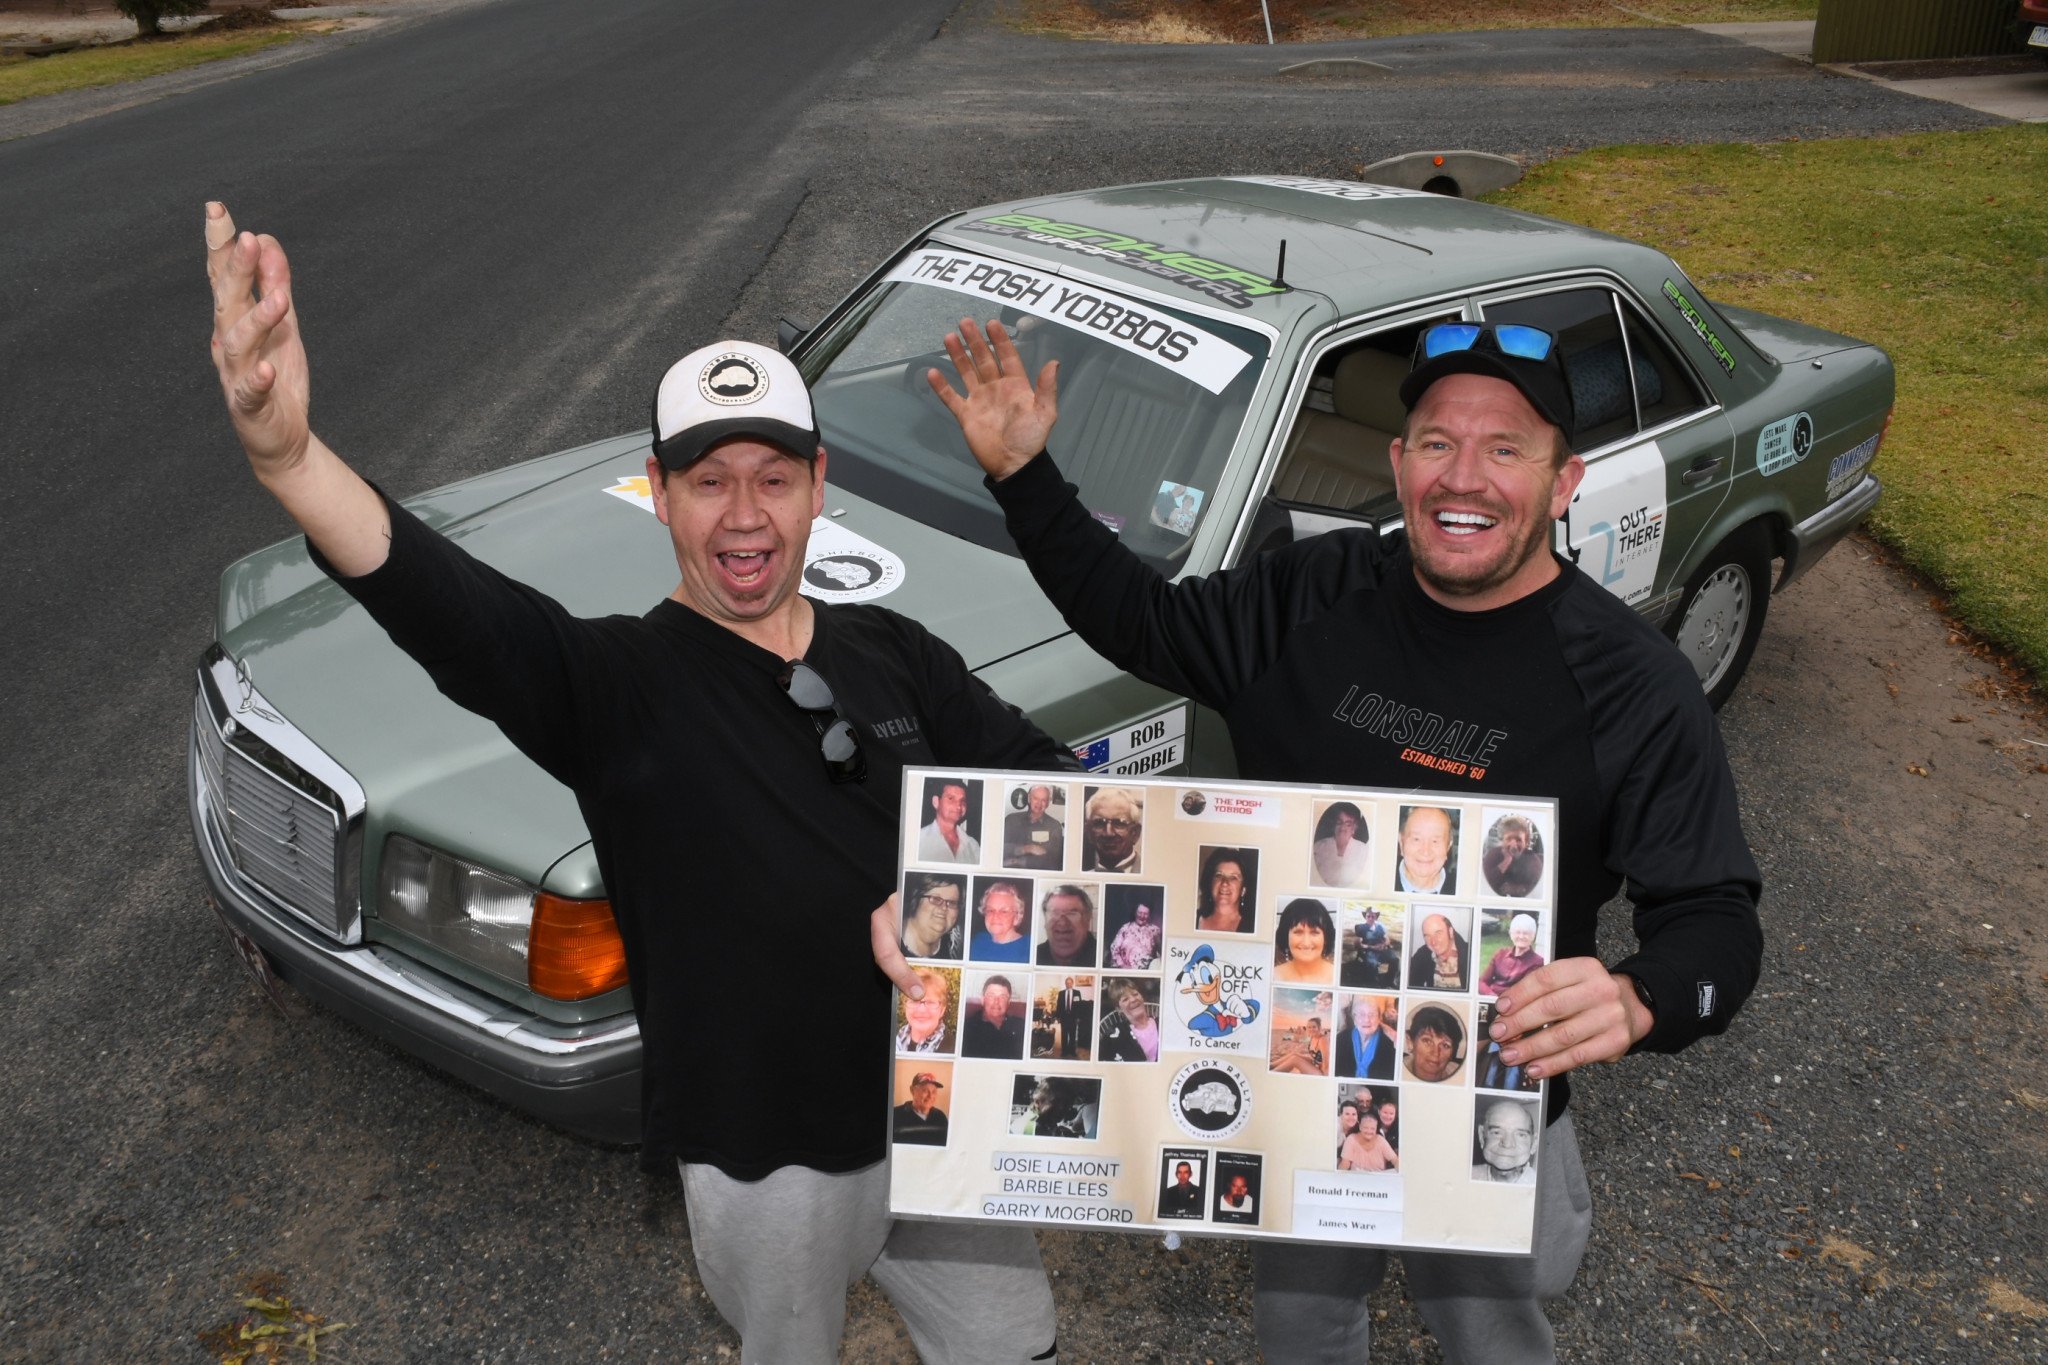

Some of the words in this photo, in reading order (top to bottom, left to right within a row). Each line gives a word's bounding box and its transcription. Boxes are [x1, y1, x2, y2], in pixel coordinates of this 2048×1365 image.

[976, 213, 1286, 296] BENHER
[911, 255, 971, 283] THE
[960, 262, 1054, 306] POSH
[1050, 287, 1199, 363] YOBBOS
[1663, 279, 1734, 370] BENHER
[701, 354, 736, 382] SHITBOX
[743, 357, 766, 381] RALLY
[1620, 506, 1648, 533] OUT
[1619, 521, 1662, 554] THERE
[1615, 542, 1659, 568] INTERNET
[1131, 720, 1165, 749] ROB
[1332, 684, 1508, 767] LONSDALE
[1400, 748, 1467, 776] ESTABLISHED
[1214, 797, 1233, 806] THE
[1236, 799, 1262, 808] POSH
[1214, 805, 1253, 815] YOBBOS
[1170, 947, 1190, 960] Say
[1223, 965, 1263, 981] DUCK
[1221, 980, 1249, 994] OFF
[1189, 1036, 1201, 1047] To
[1205, 1037, 1241, 1050] Cancer
[1171, 1060, 1218, 1095] SHITBOX
[1226, 1065, 1251, 1103] RALLY
[994, 1158, 1042, 1173] JOSIE
[1047, 1160, 1120, 1177] LAMONT
[1003, 1178, 1063, 1195] BARBIE
[1067, 1182, 1108, 1197] LEES
[1308, 1186, 1342, 1196] Ronald
[1345, 1189, 1389, 1199] Freeman
[983, 1202, 1041, 1217] GARRY
[1045, 1205, 1133, 1223] MOGFORD
[1318, 1219, 1348, 1229] James
[1351, 1221, 1377, 1231] Ware
